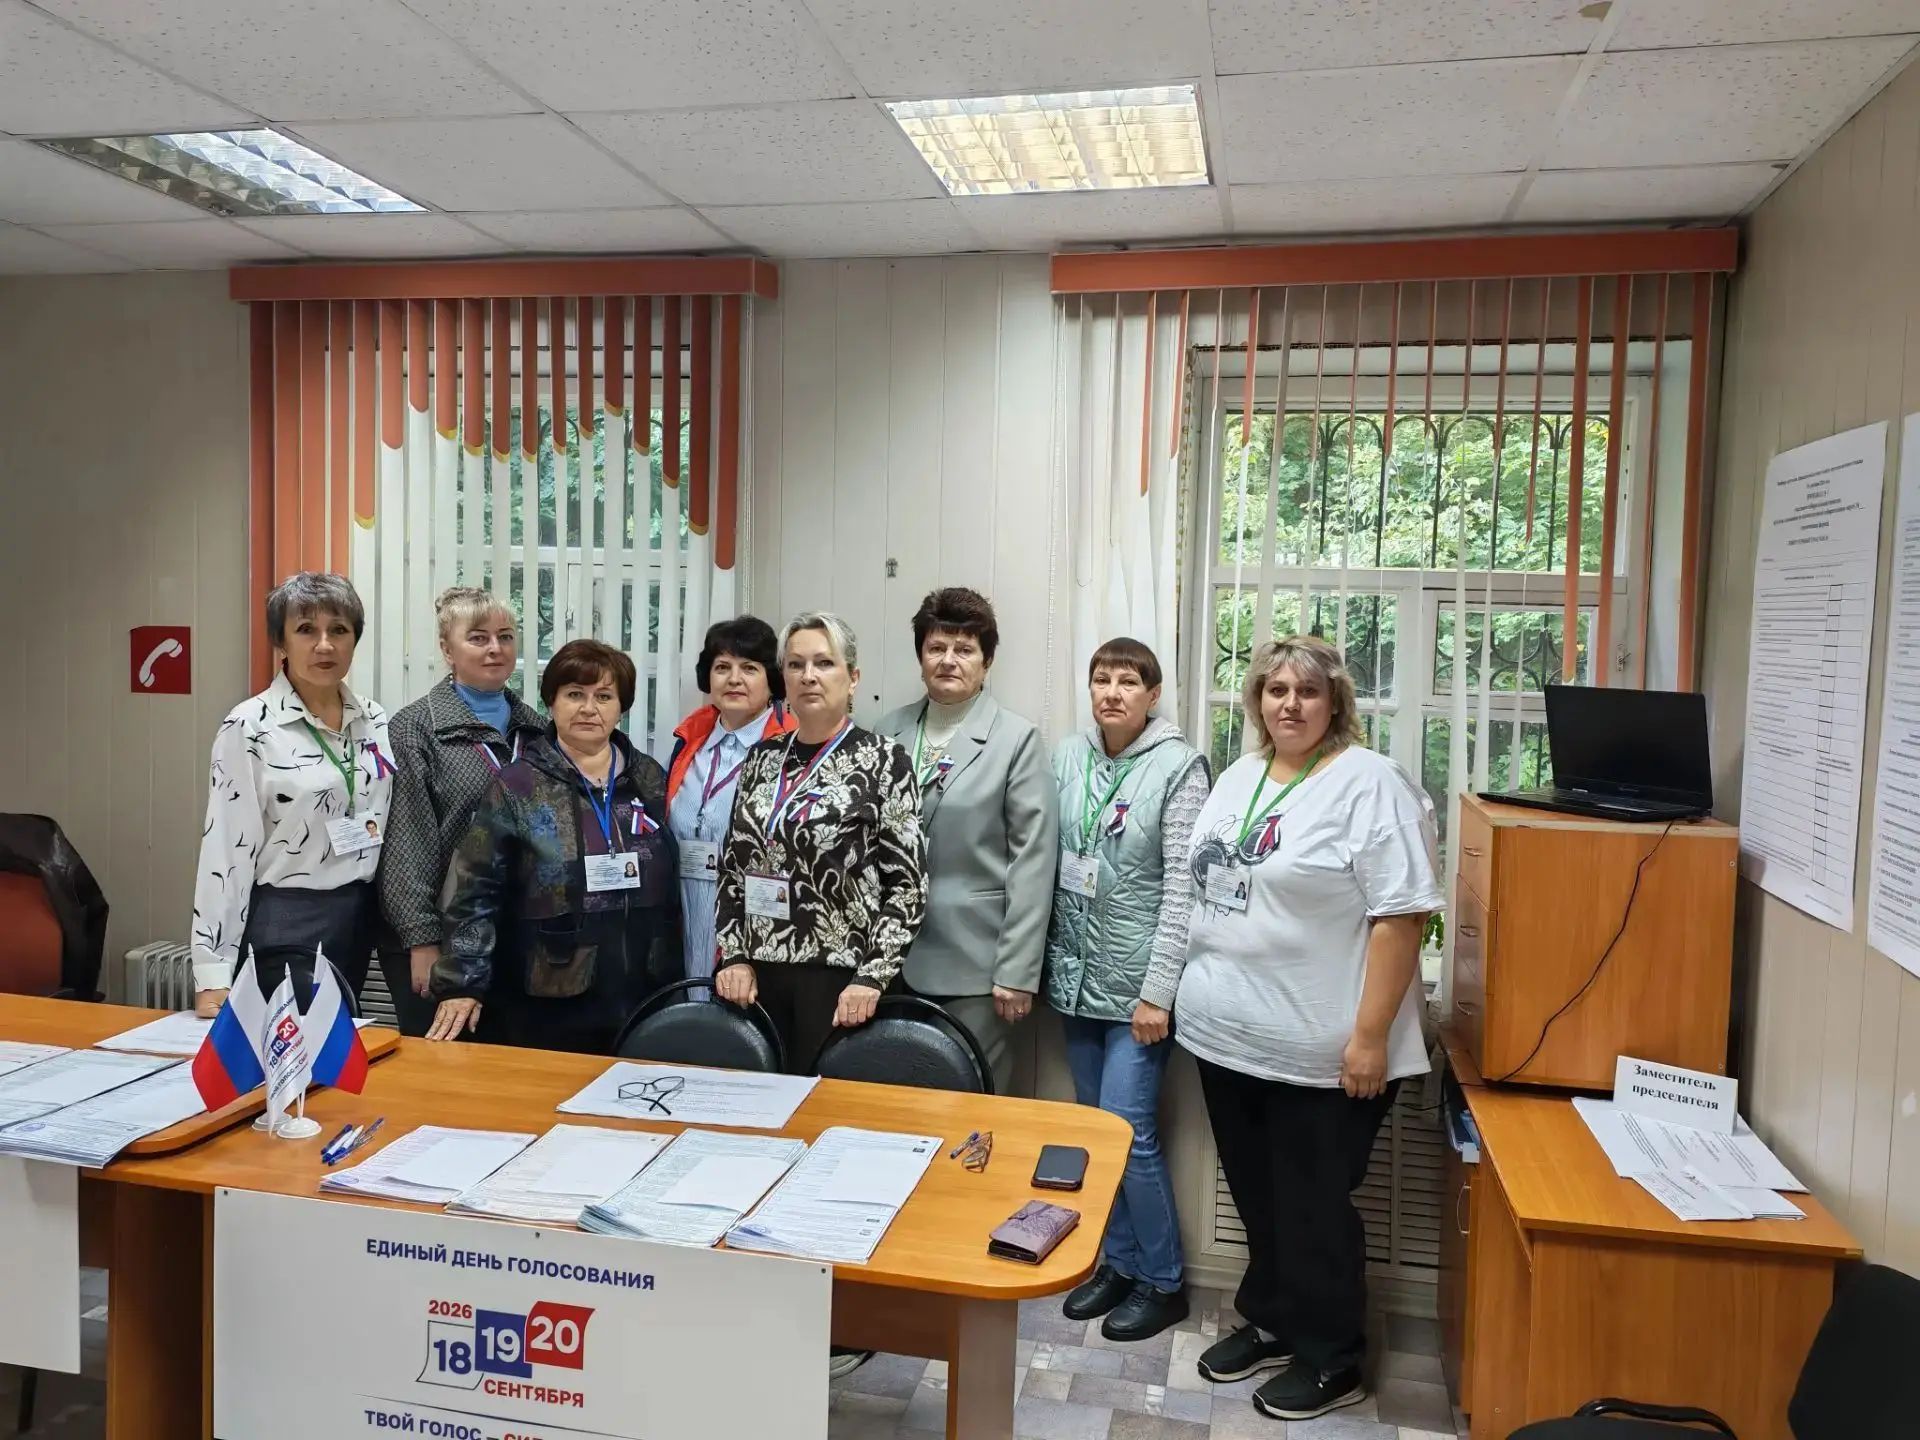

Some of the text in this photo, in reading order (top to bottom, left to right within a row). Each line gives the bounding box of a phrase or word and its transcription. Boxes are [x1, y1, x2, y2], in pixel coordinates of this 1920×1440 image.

[269, 1021, 295, 1069] 18 19 20
[1634, 1064, 1716, 1091] Заместитель
[1632, 1084, 1719, 1110] председателя
[366, 1238, 655, 1291] ЕДИНЫЙ ДЕНЬ ГОЛОСОВАНИЯ
[428, 1300, 473, 1319] 2026
[433, 1315, 581, 1375] 18 19 20
[484, 1379, 584, 1408] СЕНТЯБРЯ
[364, 1410, 414, 1432] ТВОЙ
[419, 1419, 482, 1440] ГОЛОС
